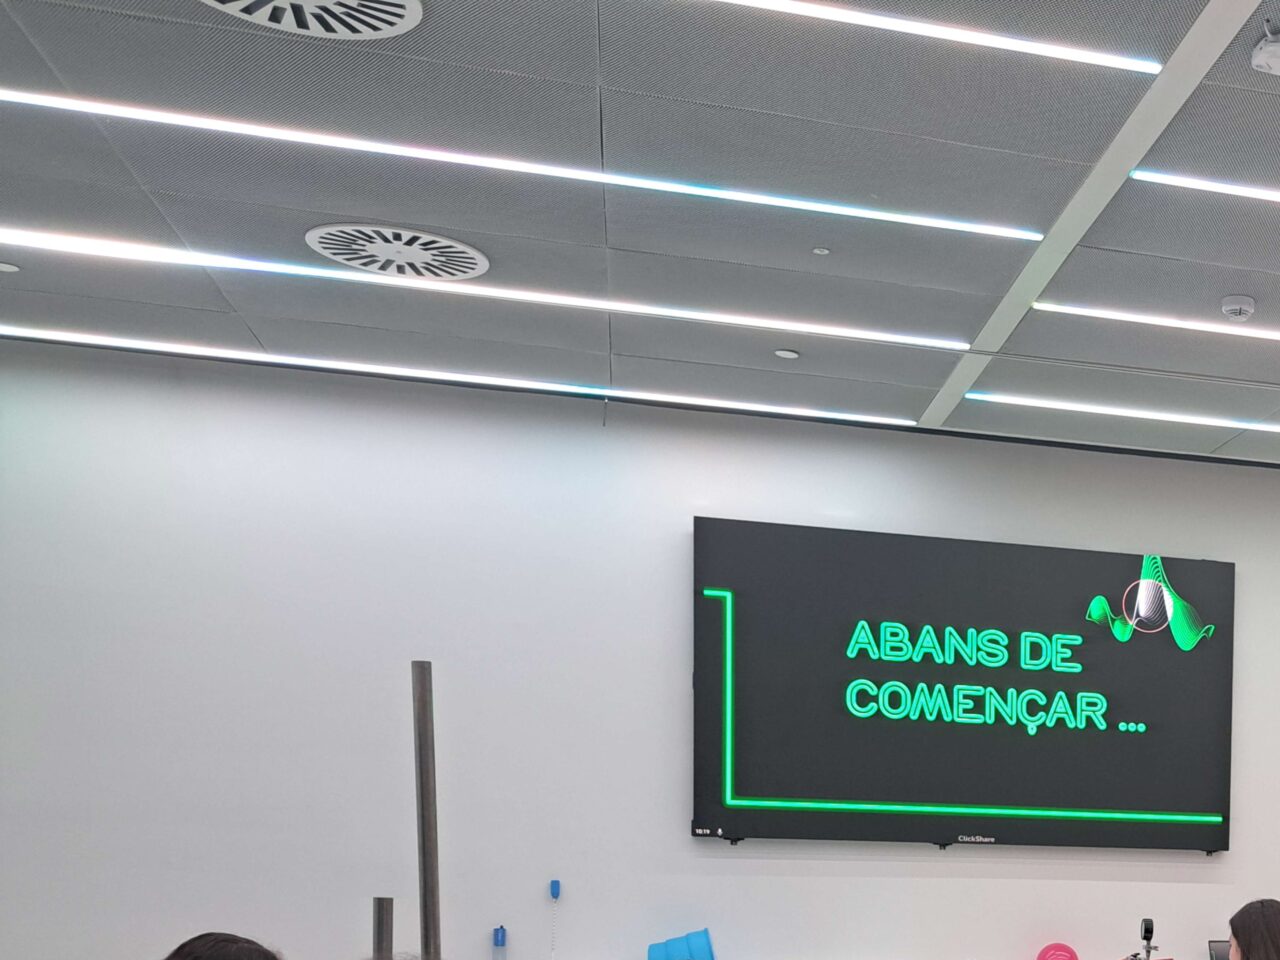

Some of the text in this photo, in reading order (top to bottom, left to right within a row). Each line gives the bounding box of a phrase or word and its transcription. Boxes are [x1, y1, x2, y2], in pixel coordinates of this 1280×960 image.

[846, 620, 1083, 673] ABANS DE
[846, 679, 1107, 736] COMENÇAR
[958, 834, 995, 843] ClickShare
